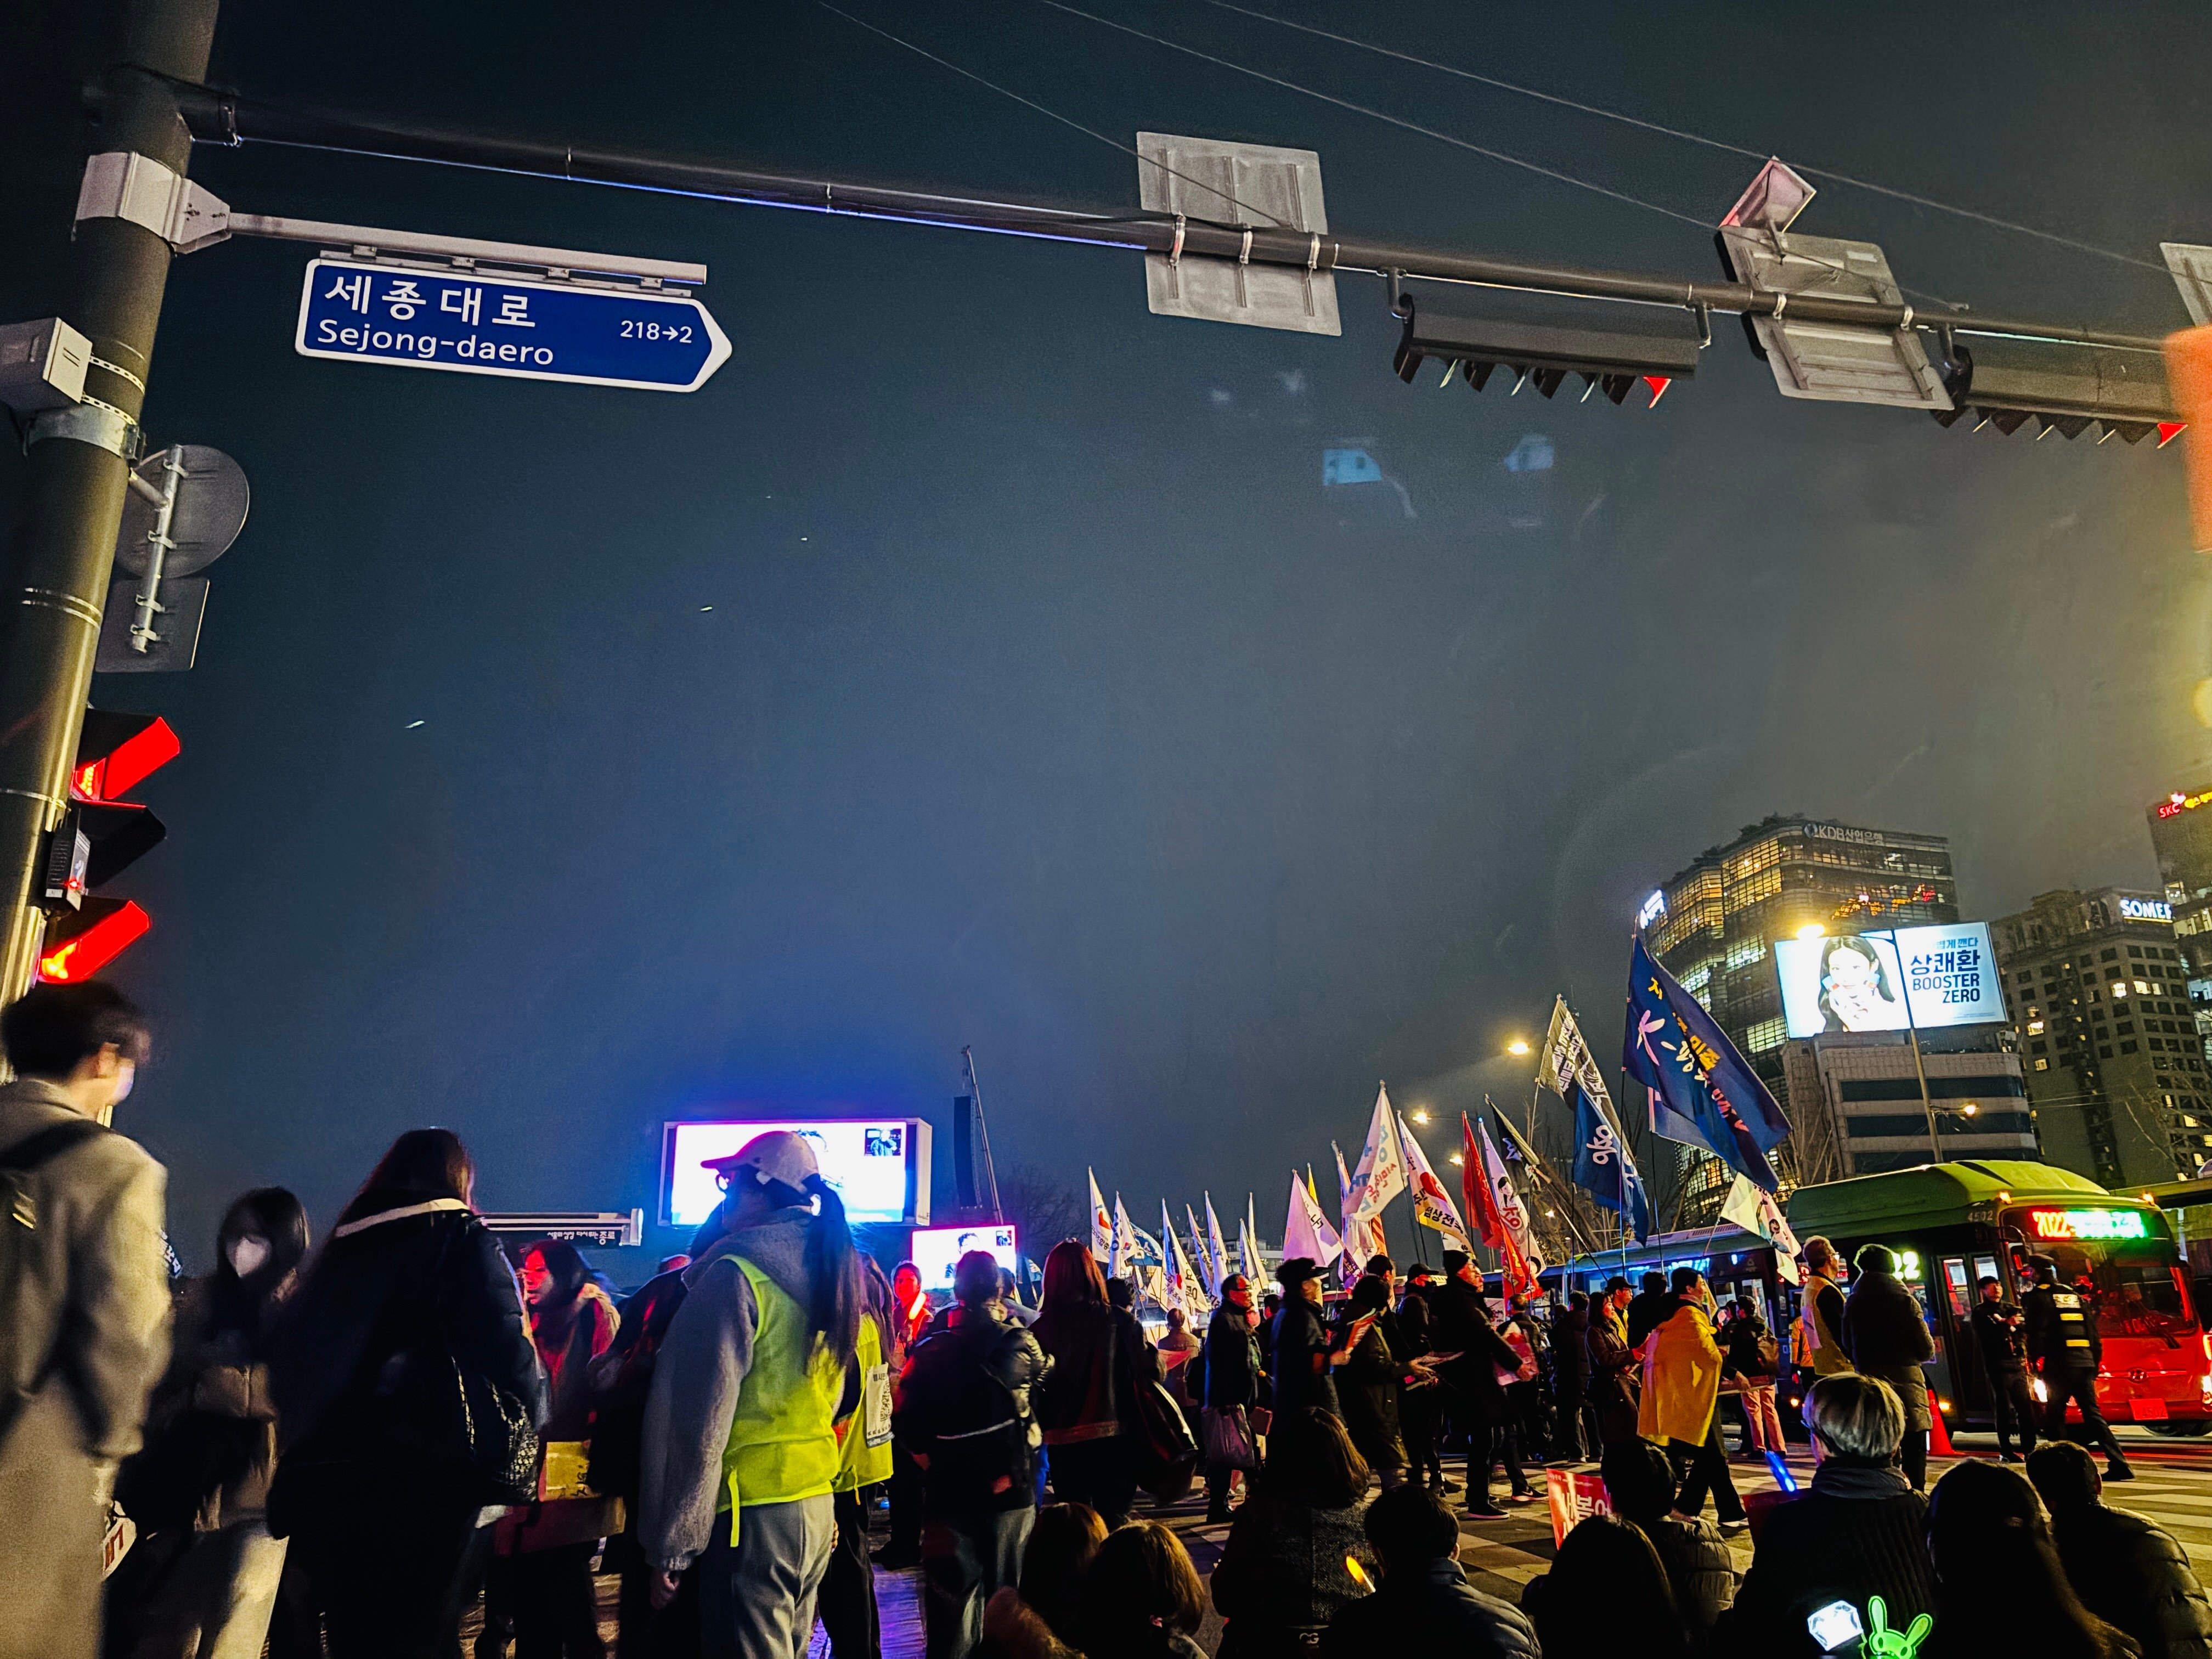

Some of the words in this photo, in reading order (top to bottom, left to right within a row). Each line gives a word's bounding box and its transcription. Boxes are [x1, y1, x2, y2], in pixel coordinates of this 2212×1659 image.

[325, 275, 536, 328] 세종대로
[318, 319, 554, 365] Sejong-daero
[2159, 803, 2180, 818] SKC
[1910, 950, 1980, 975] 상쾌환
[1912, 973, 1979, 991] BOOSTER
[1943, 988, 1980, 1003] ZERO
[2032, 1211, 2072, 1238] 7022
[599, 1231, 616, 1245] 종로
